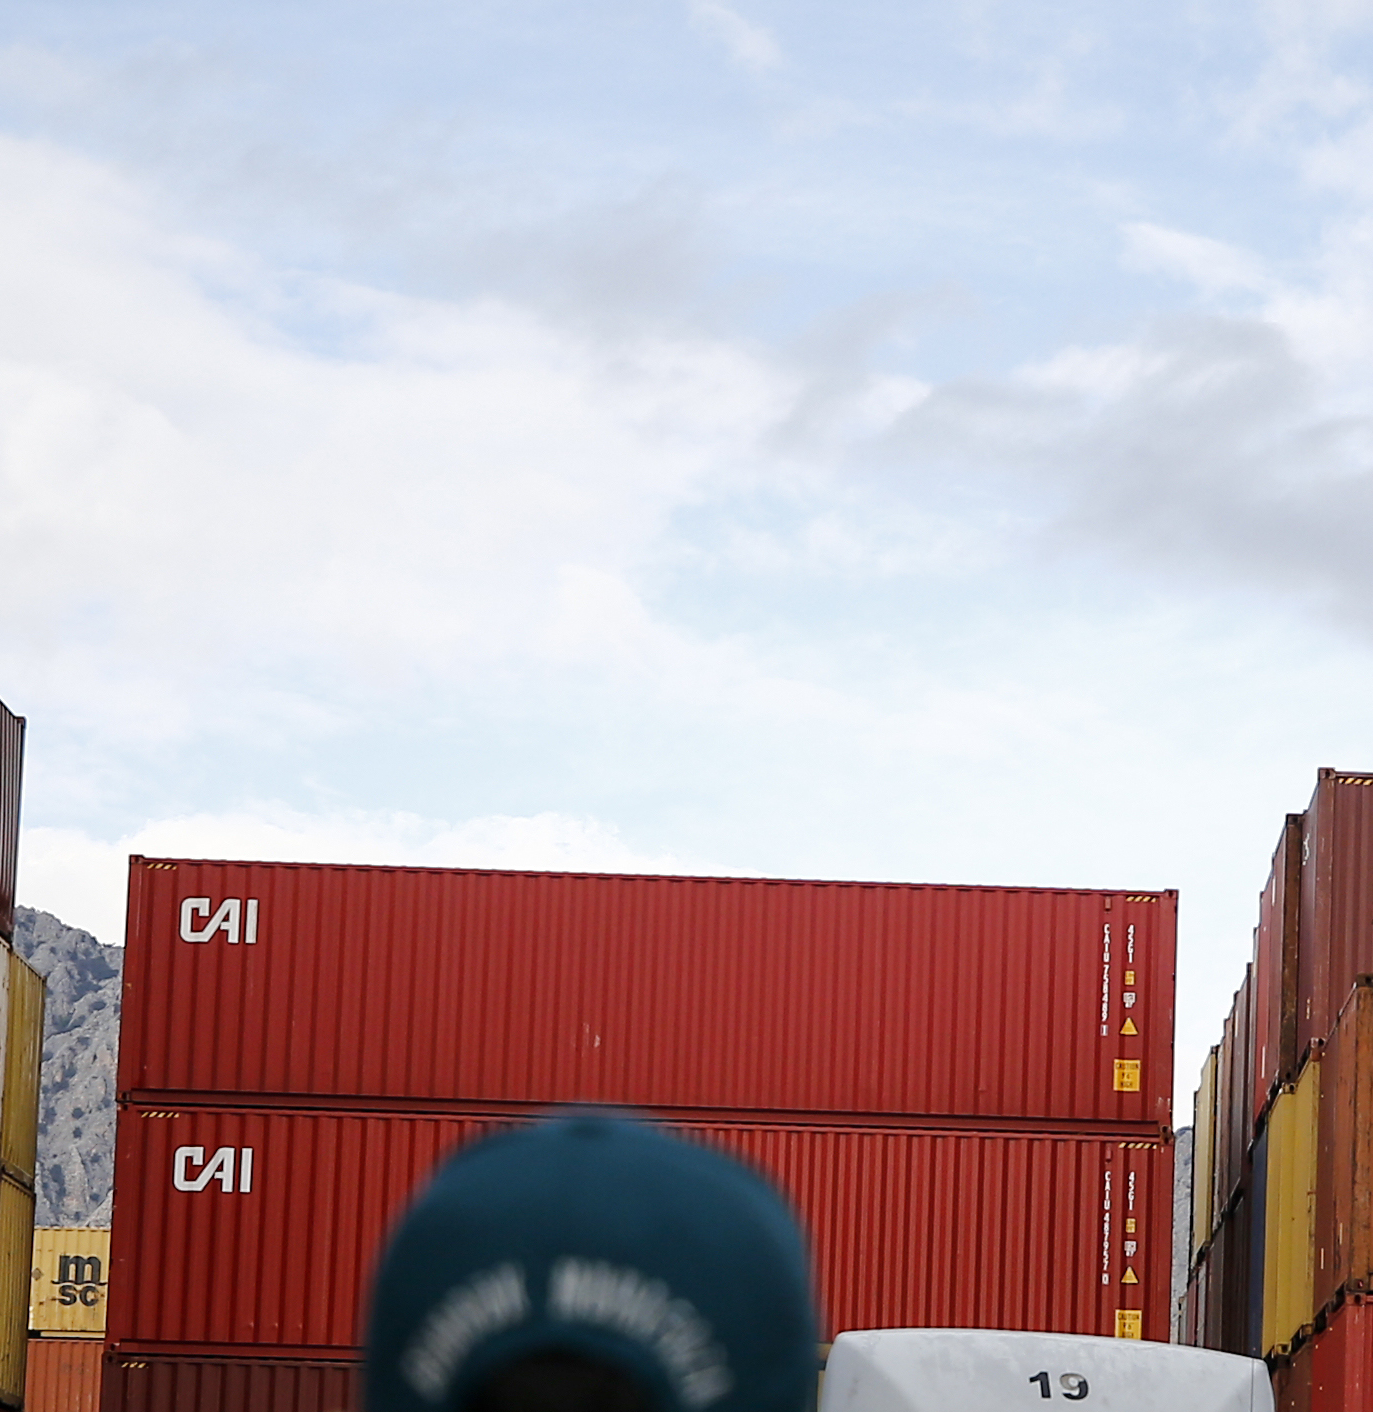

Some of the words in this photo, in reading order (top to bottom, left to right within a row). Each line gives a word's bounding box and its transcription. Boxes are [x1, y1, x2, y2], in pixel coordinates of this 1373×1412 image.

[180, 897, 259, 944] CAI
[1103, 923, 1111, 962] CAIU
[173, 1146, 253, 1193] CAI
[1103, 1171, 1112, 1210] CAIU
[1029, 1371, 1089, 1401] 19
